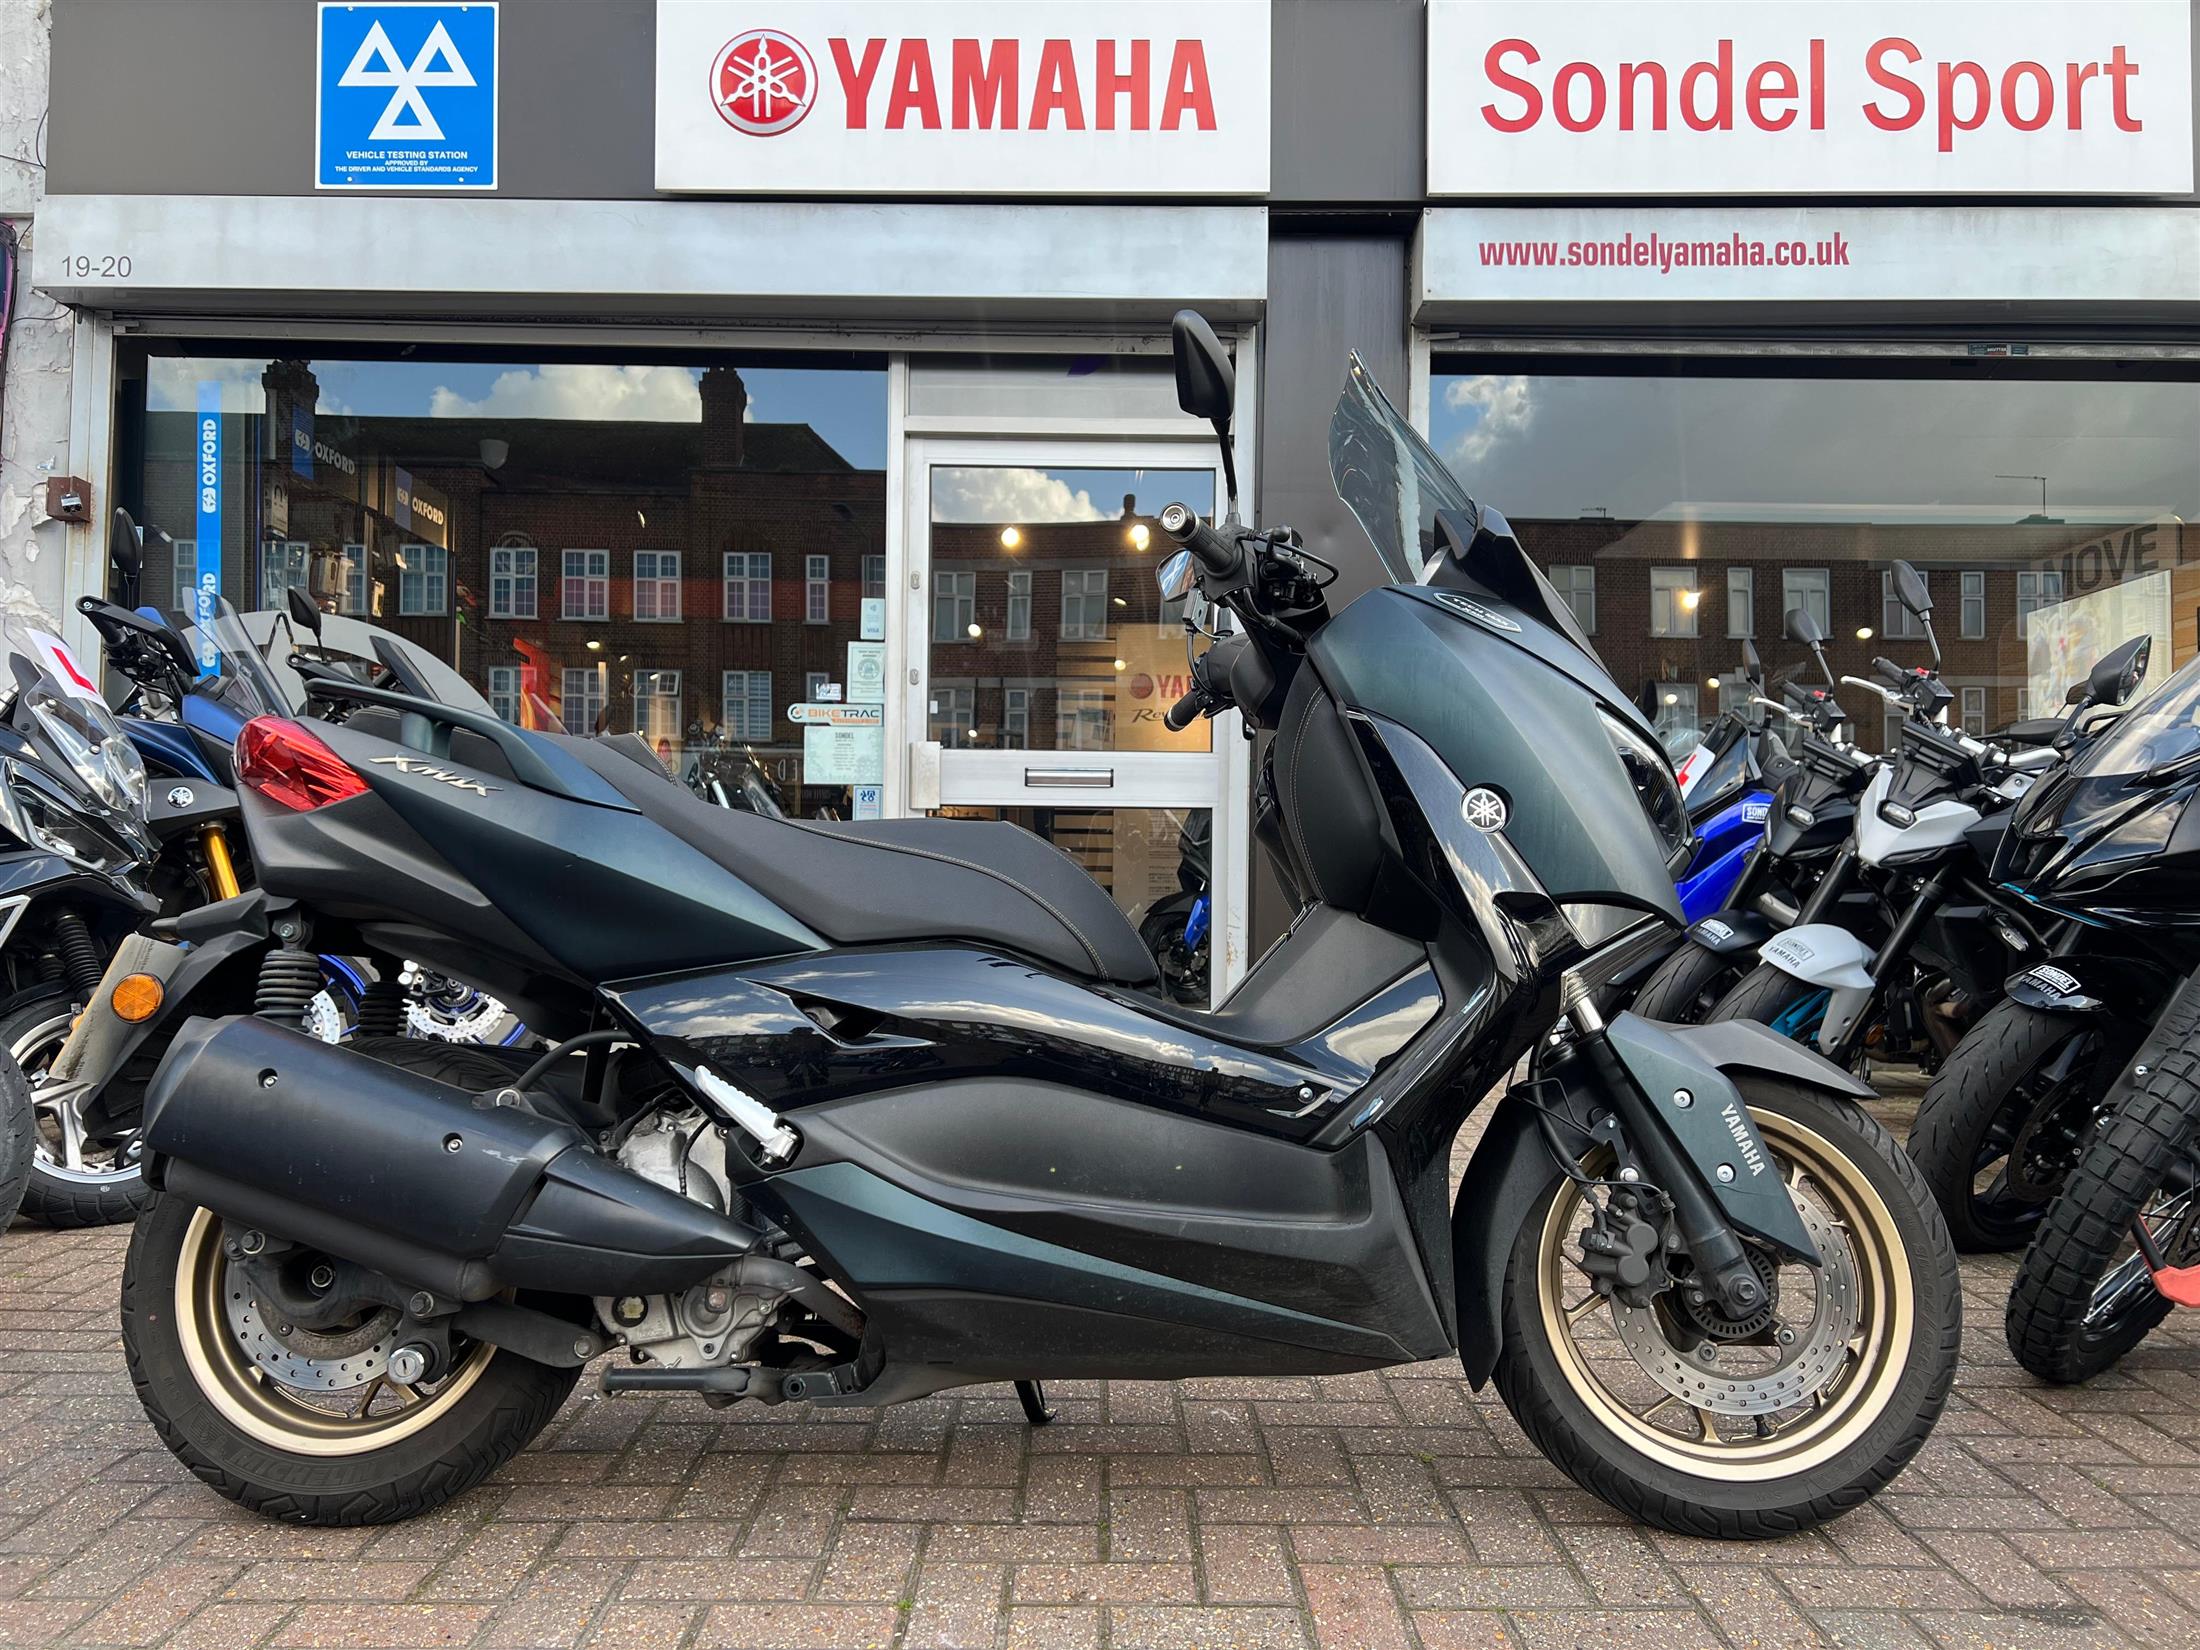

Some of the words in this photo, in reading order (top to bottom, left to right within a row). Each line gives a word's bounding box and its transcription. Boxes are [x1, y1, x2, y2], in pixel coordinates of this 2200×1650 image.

[827, 38, 1217, 131] YAMAHA
[1480, 38, 1826, 133] Sondel
[1862, 37, 2143, 152] Sport
[346, 151, 384, 159] VEHICLE
[386, 151, 426, 159] TESTING
[428, 151, 468, 159] STATION
[61, 255, 132, 278] 19-20
[1478, 232, 1850, 274] www.sondelyamaha.co.uk
[202, 418, 217, 486] OXFORD
[314, 441, 355, 475] OXFORD
[412, 496, 444, 526] OXFORD
[2043, 523, 2160, 597] MOVE
[808, 709, 880, 718] BIKETRAC
[1746, 806, 1768, 817] SOND
[1769, 945, 1801, 969] YAMAHA
[2018, 974, 2062, 1001] YAMAHA
[2038, 966, 2074, 987] SONDEL
[1720, 1102, 1766, 1178] YAMAHA
